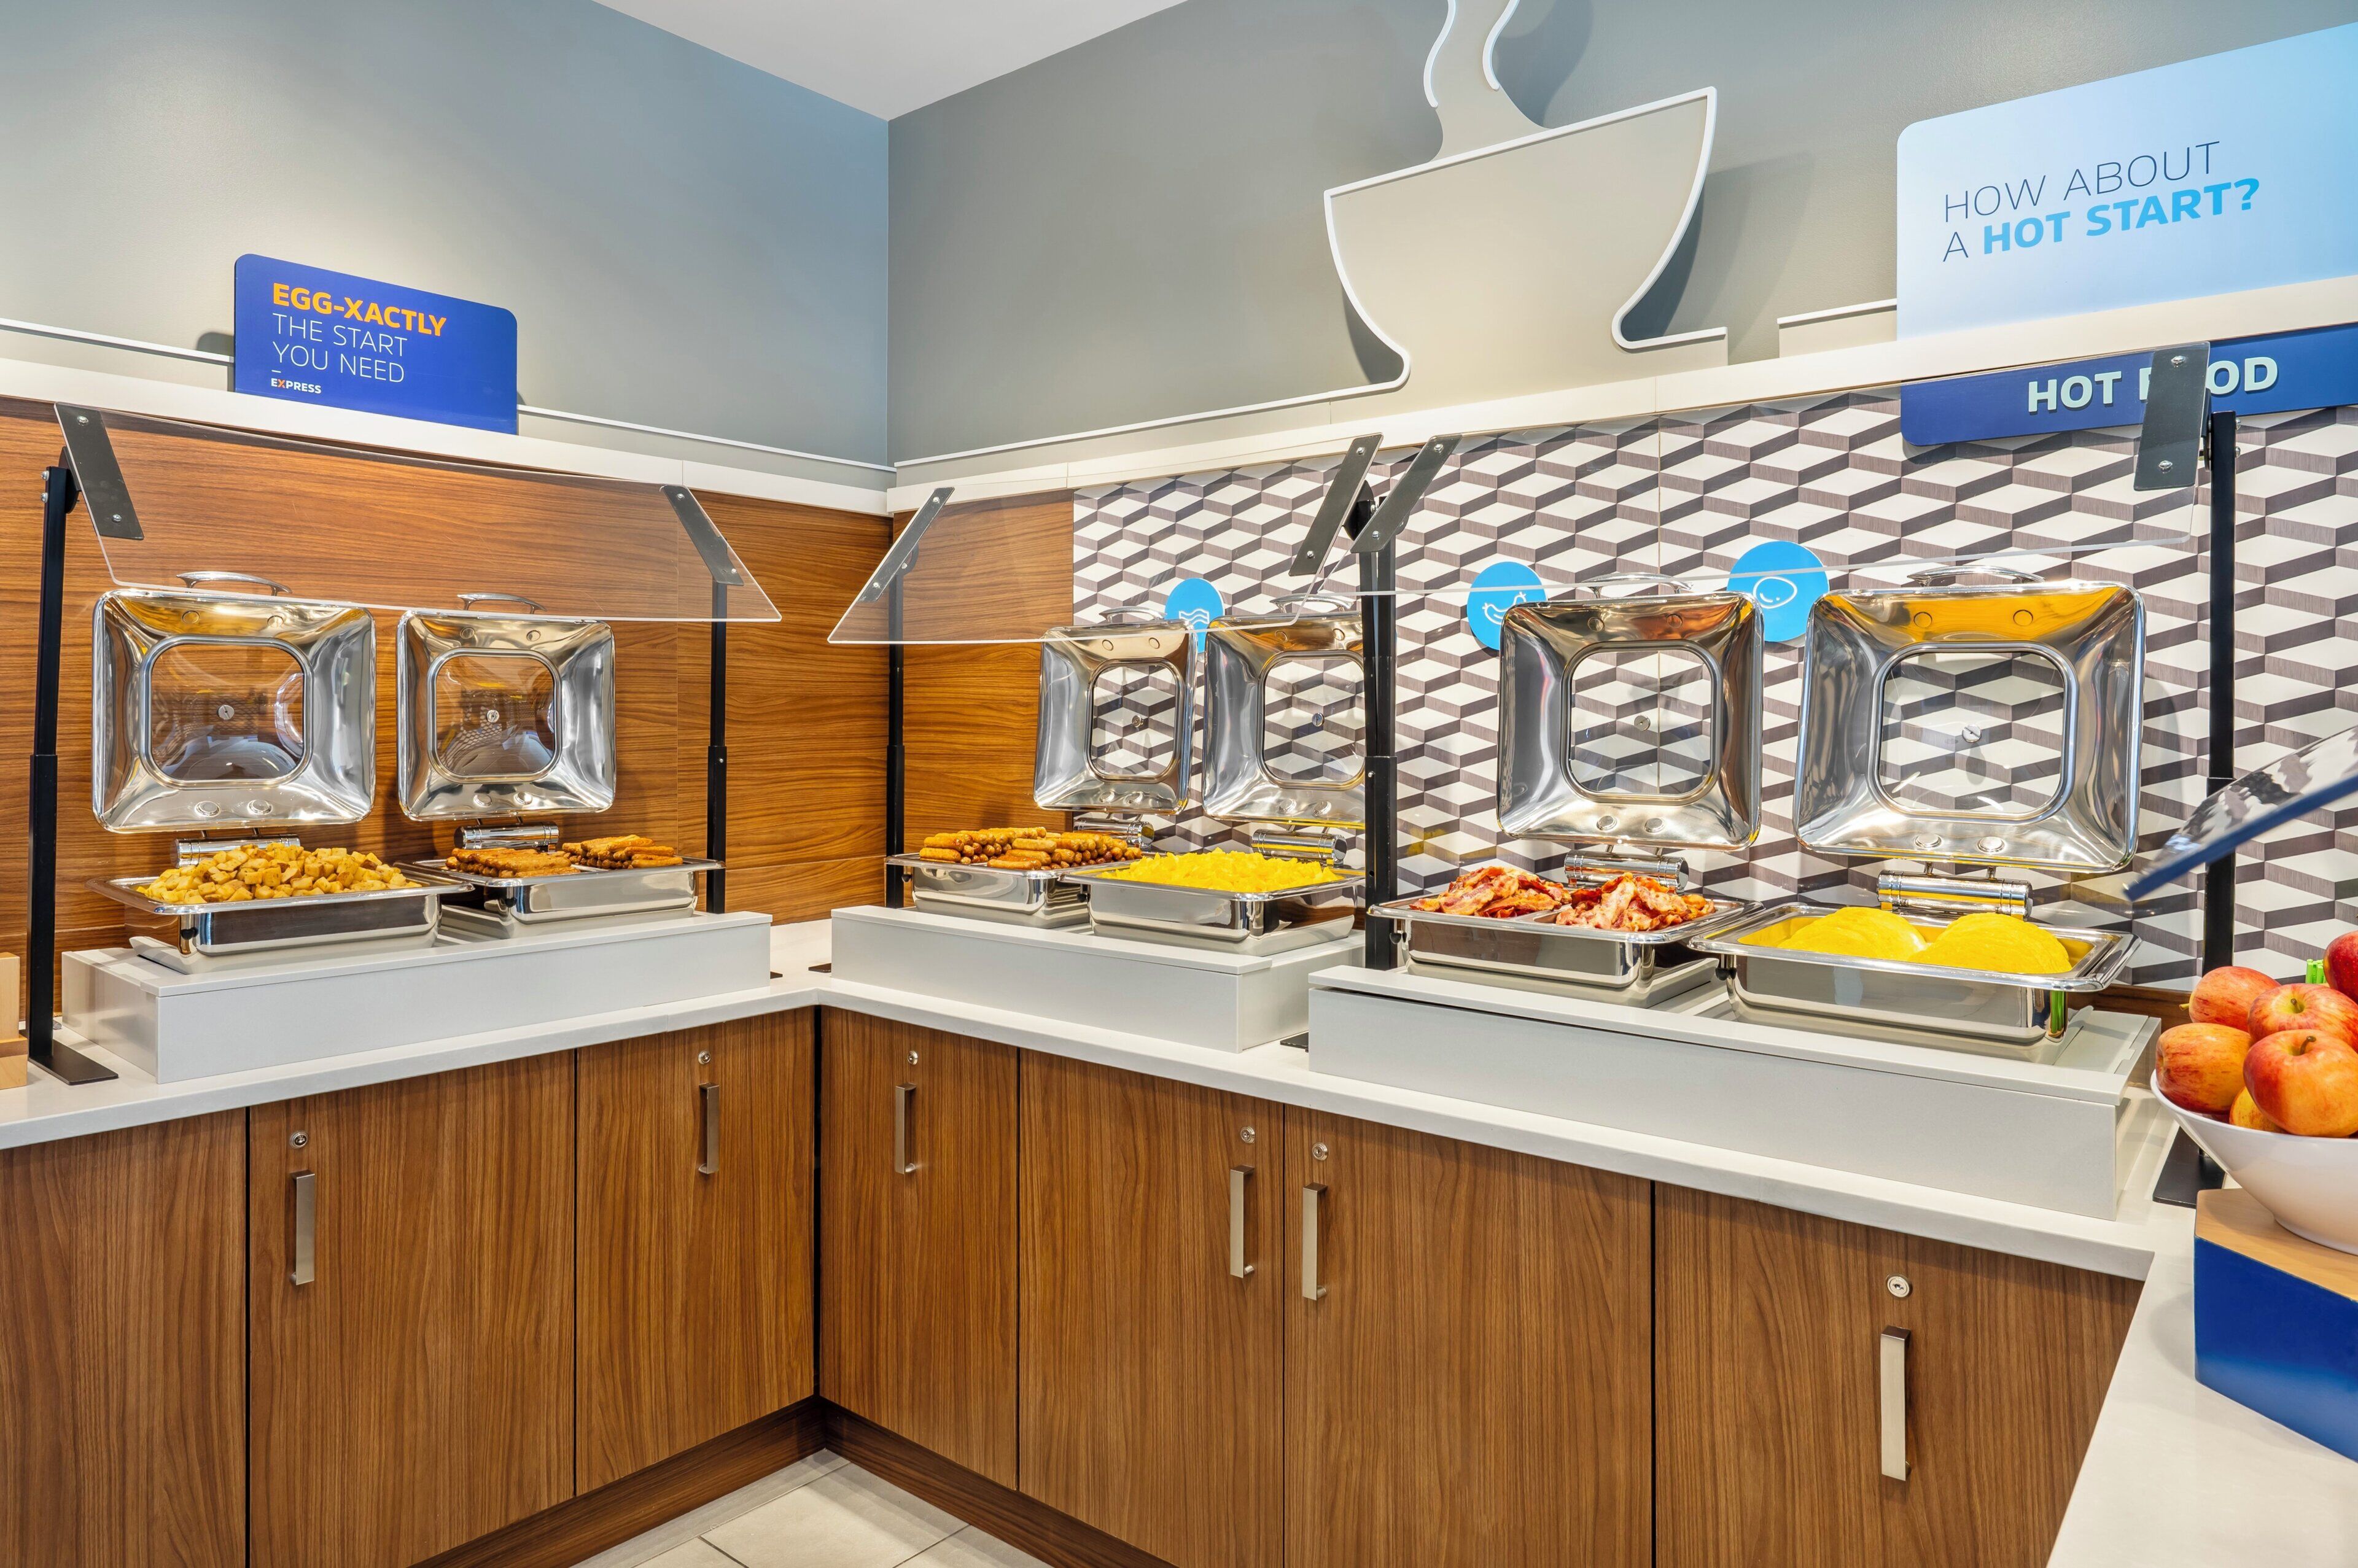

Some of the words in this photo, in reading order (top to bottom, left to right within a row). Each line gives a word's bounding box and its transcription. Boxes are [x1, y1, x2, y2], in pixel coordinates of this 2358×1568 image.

[1945, 175, 2046, 223] HOW
[2063, 141, 2220, 201] ABOUT
[1943, 231, 1969, 262] A
[1984, 211, 2071, 254] HOT
[2086, 177, 2260, 236] START?
[273, 282, 447, 337] EGG-XACTLY
[273, 312, 323, 342] THE
[333, 325, 408, 357] START
[271, 378, 322, 394] EXPRESS
[273, 341, 328, 370] YOU
[340, 353, 405, 383] NEED
[2028, 371, 2122, 413] HOT
[2139, 357, 2278, 400] FOD
